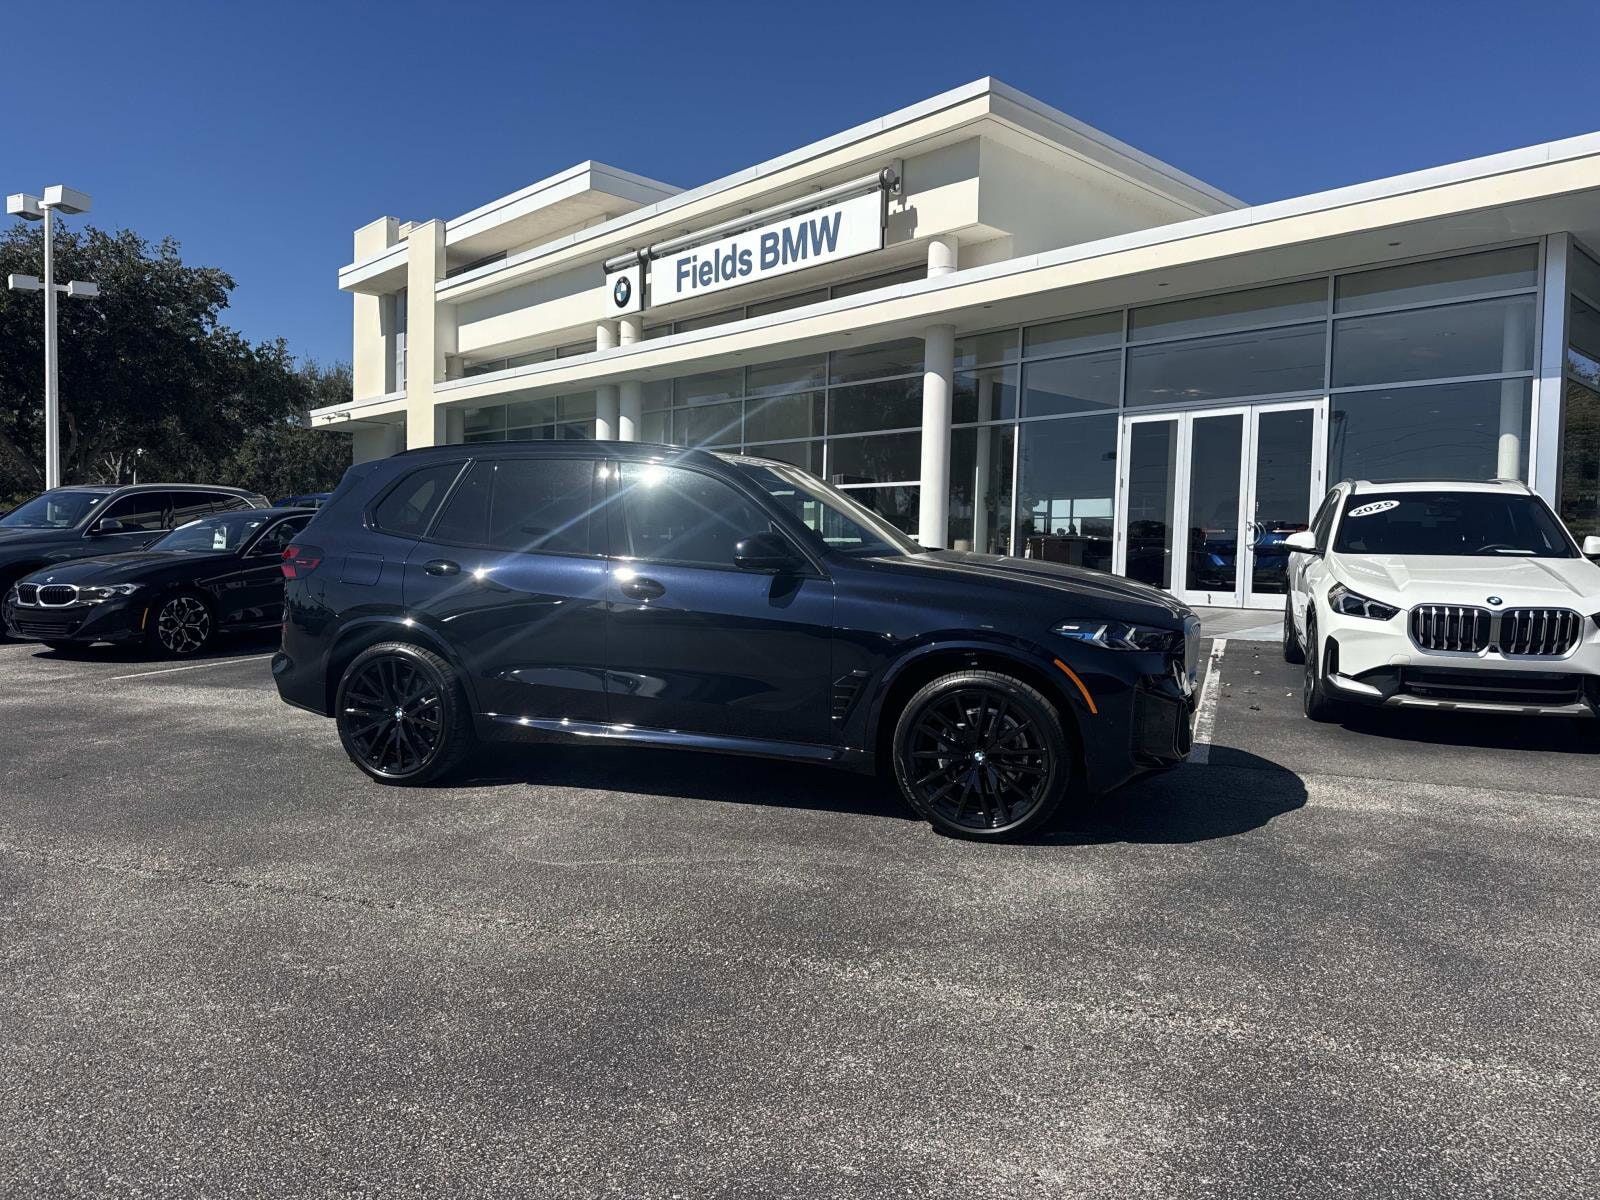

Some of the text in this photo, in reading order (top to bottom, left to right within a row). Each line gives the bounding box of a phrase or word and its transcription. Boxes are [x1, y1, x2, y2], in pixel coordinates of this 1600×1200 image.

[676, 211, 842, 292] Fields BMW
[1353, 502, 1394, 515] 2025
